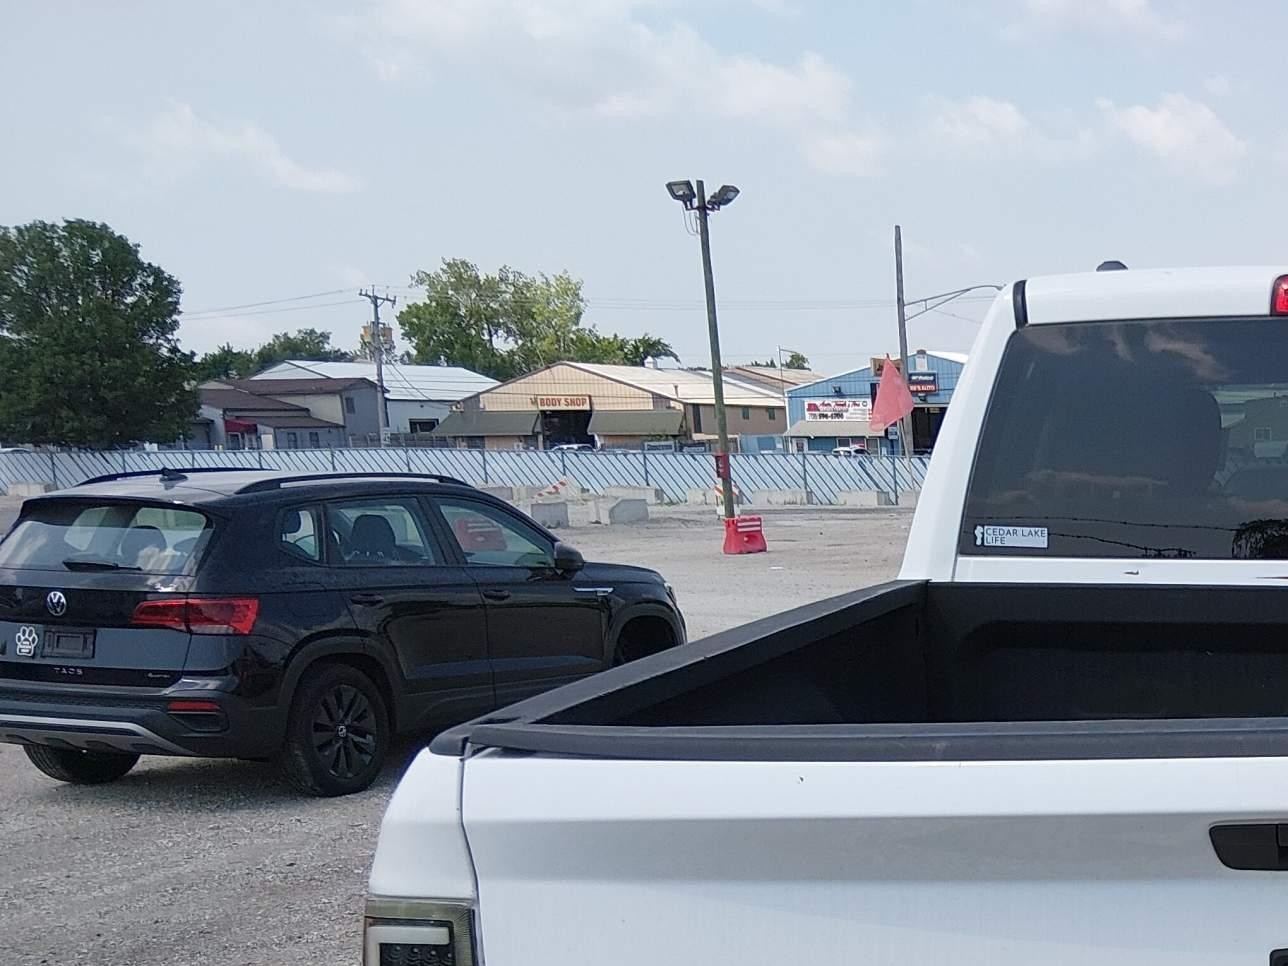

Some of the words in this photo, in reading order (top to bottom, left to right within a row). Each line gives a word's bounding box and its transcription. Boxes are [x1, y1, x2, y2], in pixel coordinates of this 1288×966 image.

[540, 398, 562, 407] BODY
[564, 398, 587, 407] SHOP
[986, 528, 1018, 537] CEDAR
[1021, 528, 1046, 538] LAKE
[986, 536, 1006, 545] LIFE
